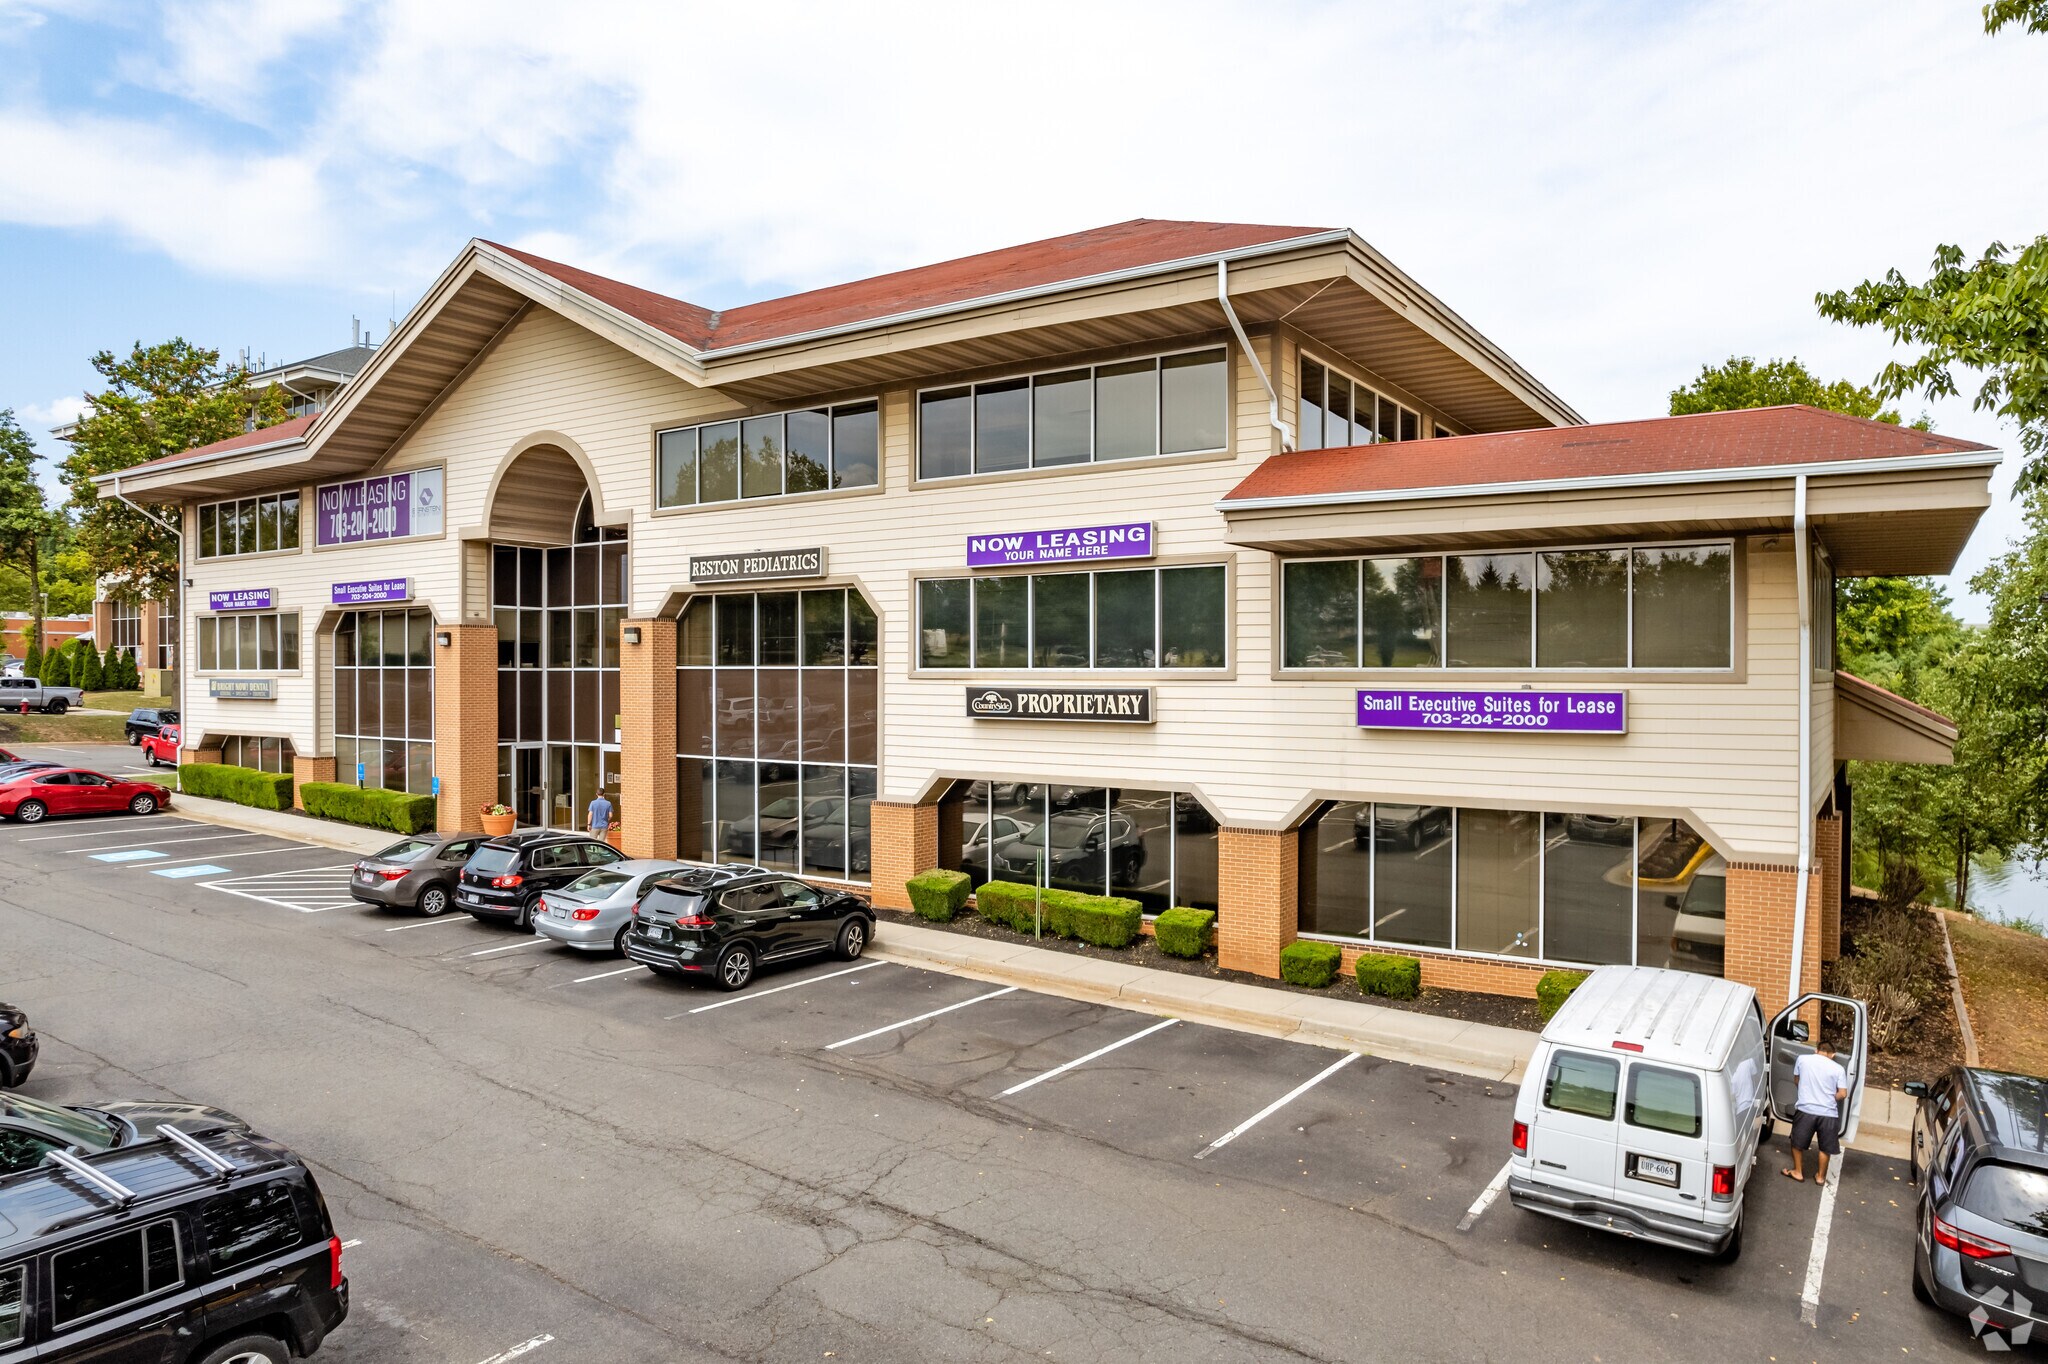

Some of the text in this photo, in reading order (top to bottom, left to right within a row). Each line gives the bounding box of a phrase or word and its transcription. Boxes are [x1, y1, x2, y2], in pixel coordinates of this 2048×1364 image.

[322, 480, 406, 512] NOW LEASING
[971, 527, 1146, 553] NOW LEASING
[1004, 545, 1109, 561] YOUR NAME HERE
[691, 553, 818, 577] RESTON PEDIATRICS
[211, 590, 269, 602] NOW LEASING
[333, 585, 346, 594] Small
[347, 584, 367, 593] Executive
[368, 583, 382, 592] Suites
[391, 582, 405, 590] Lease
[351, 592, 387, 600] 703-204-2000
[974, 693, 1143, 715] CountrySide PROPRIETARY
[1363, 695, 1616, 714] Small Executive Suites for Lease
[1422, 713, 1549, 726] 703-204-2000
[1641, 1160, 1674, 1176] UHP-6065
